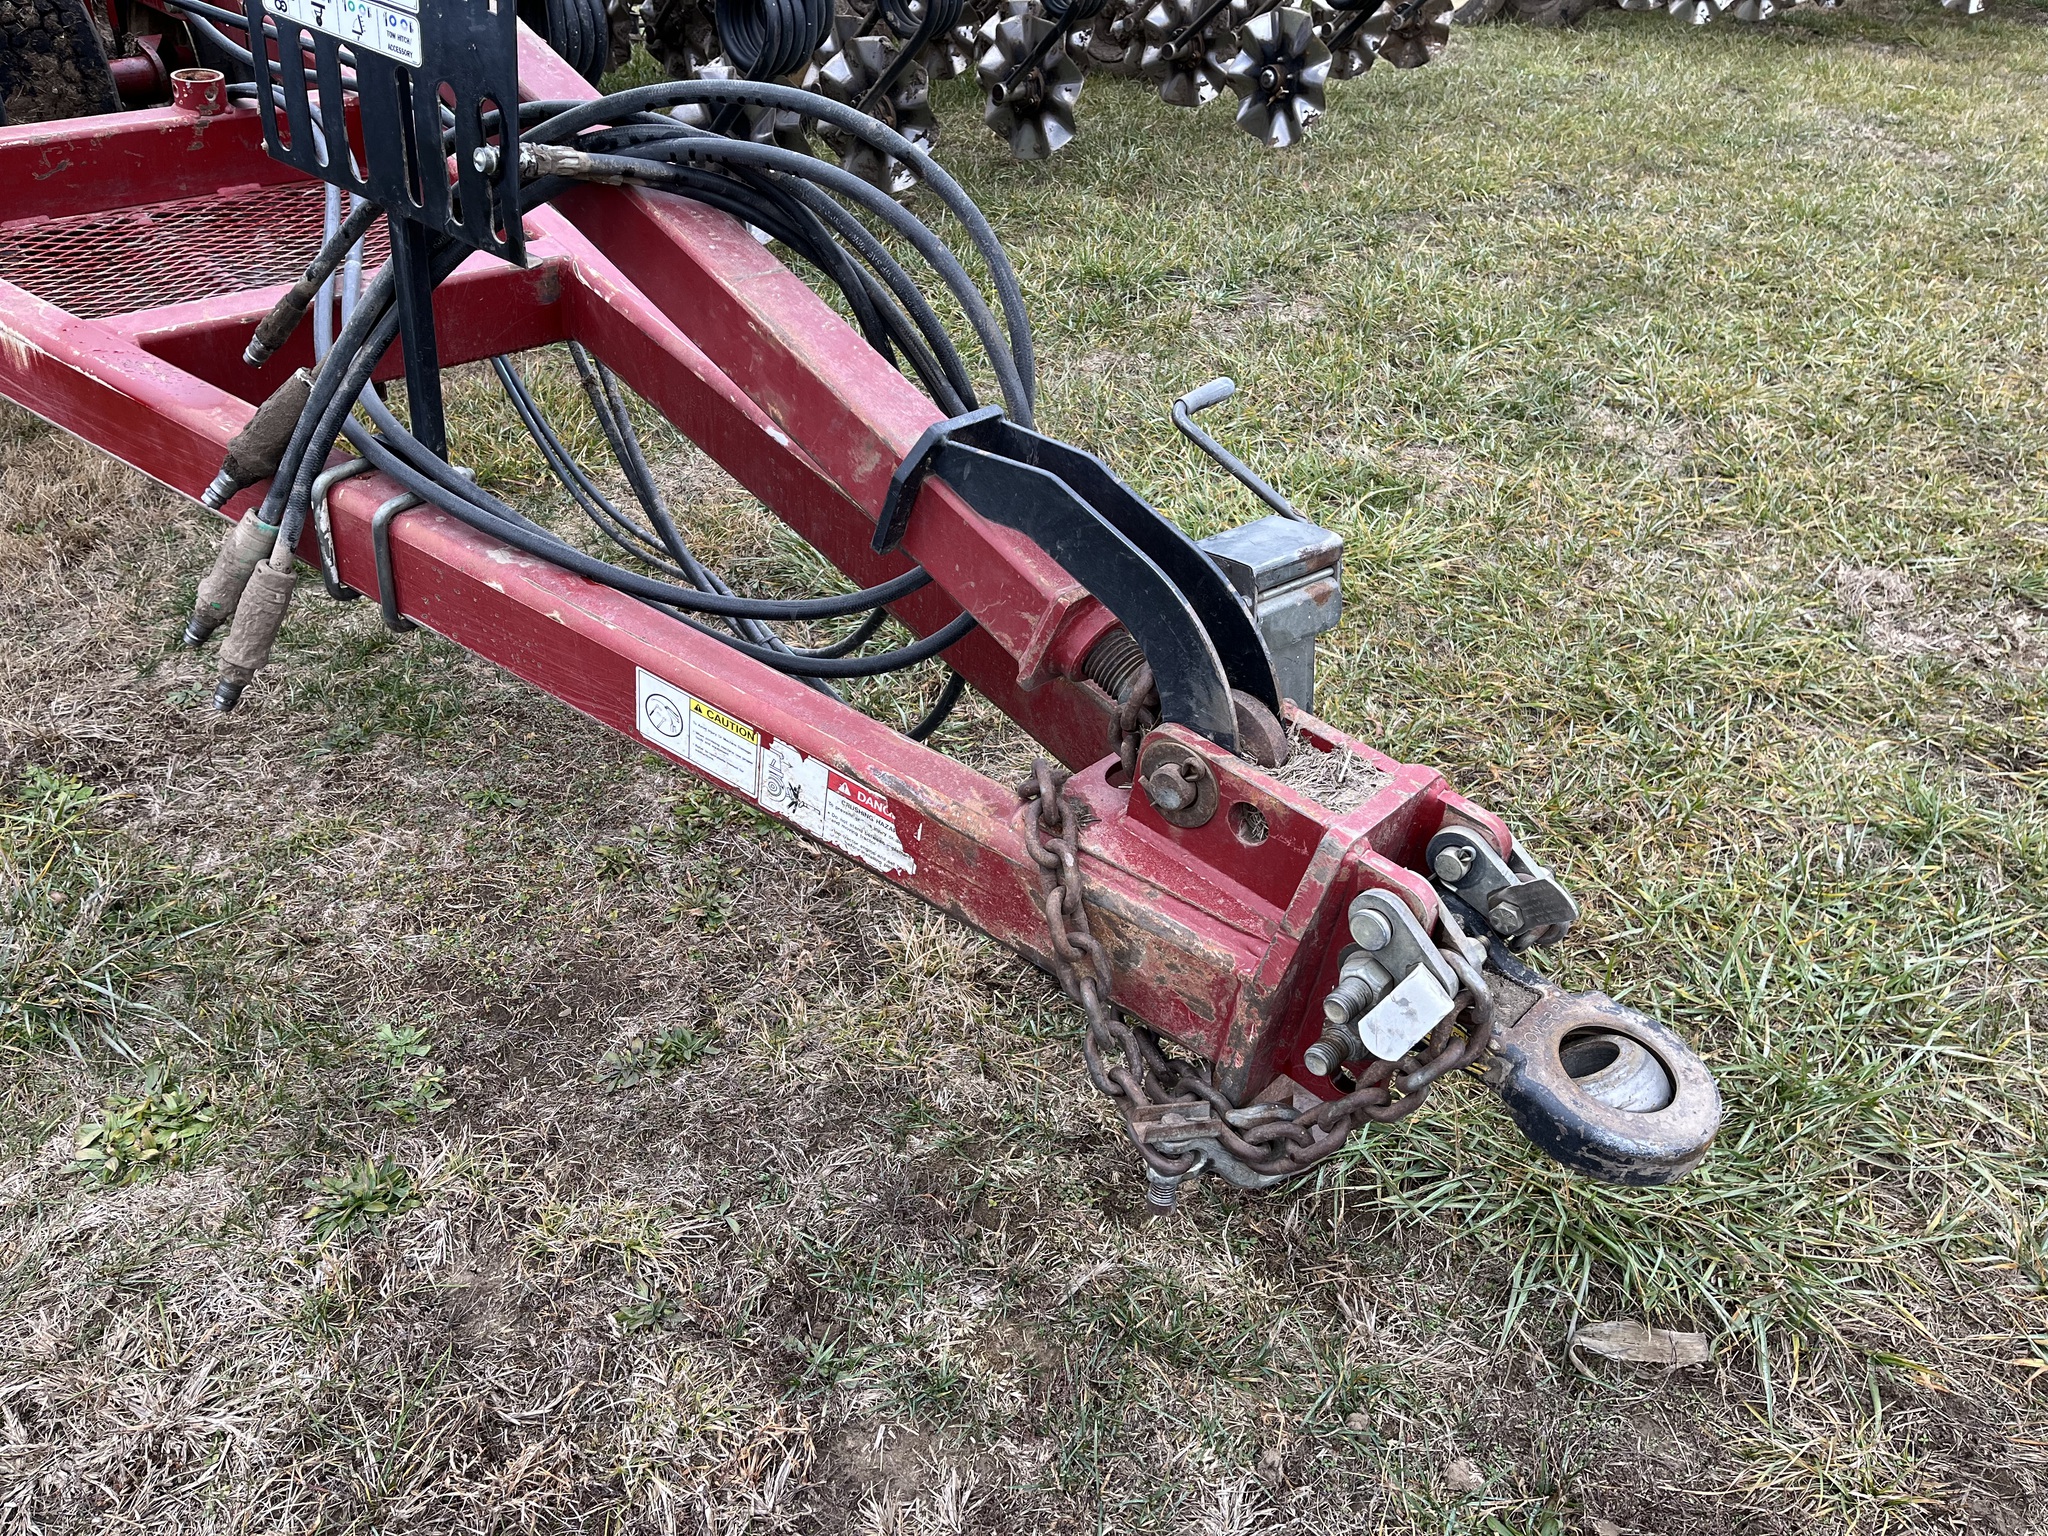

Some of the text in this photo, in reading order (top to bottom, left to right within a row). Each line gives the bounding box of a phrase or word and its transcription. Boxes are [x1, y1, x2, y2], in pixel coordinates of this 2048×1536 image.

[387, 30, 396, 39] TOW
[388, 43, 413, 58] ACCESSORY
[707, 710, 755, 742] CAUTION
[841, 799, 873, 821] CRUSHING
[857, 791, 895, 819] DANG
